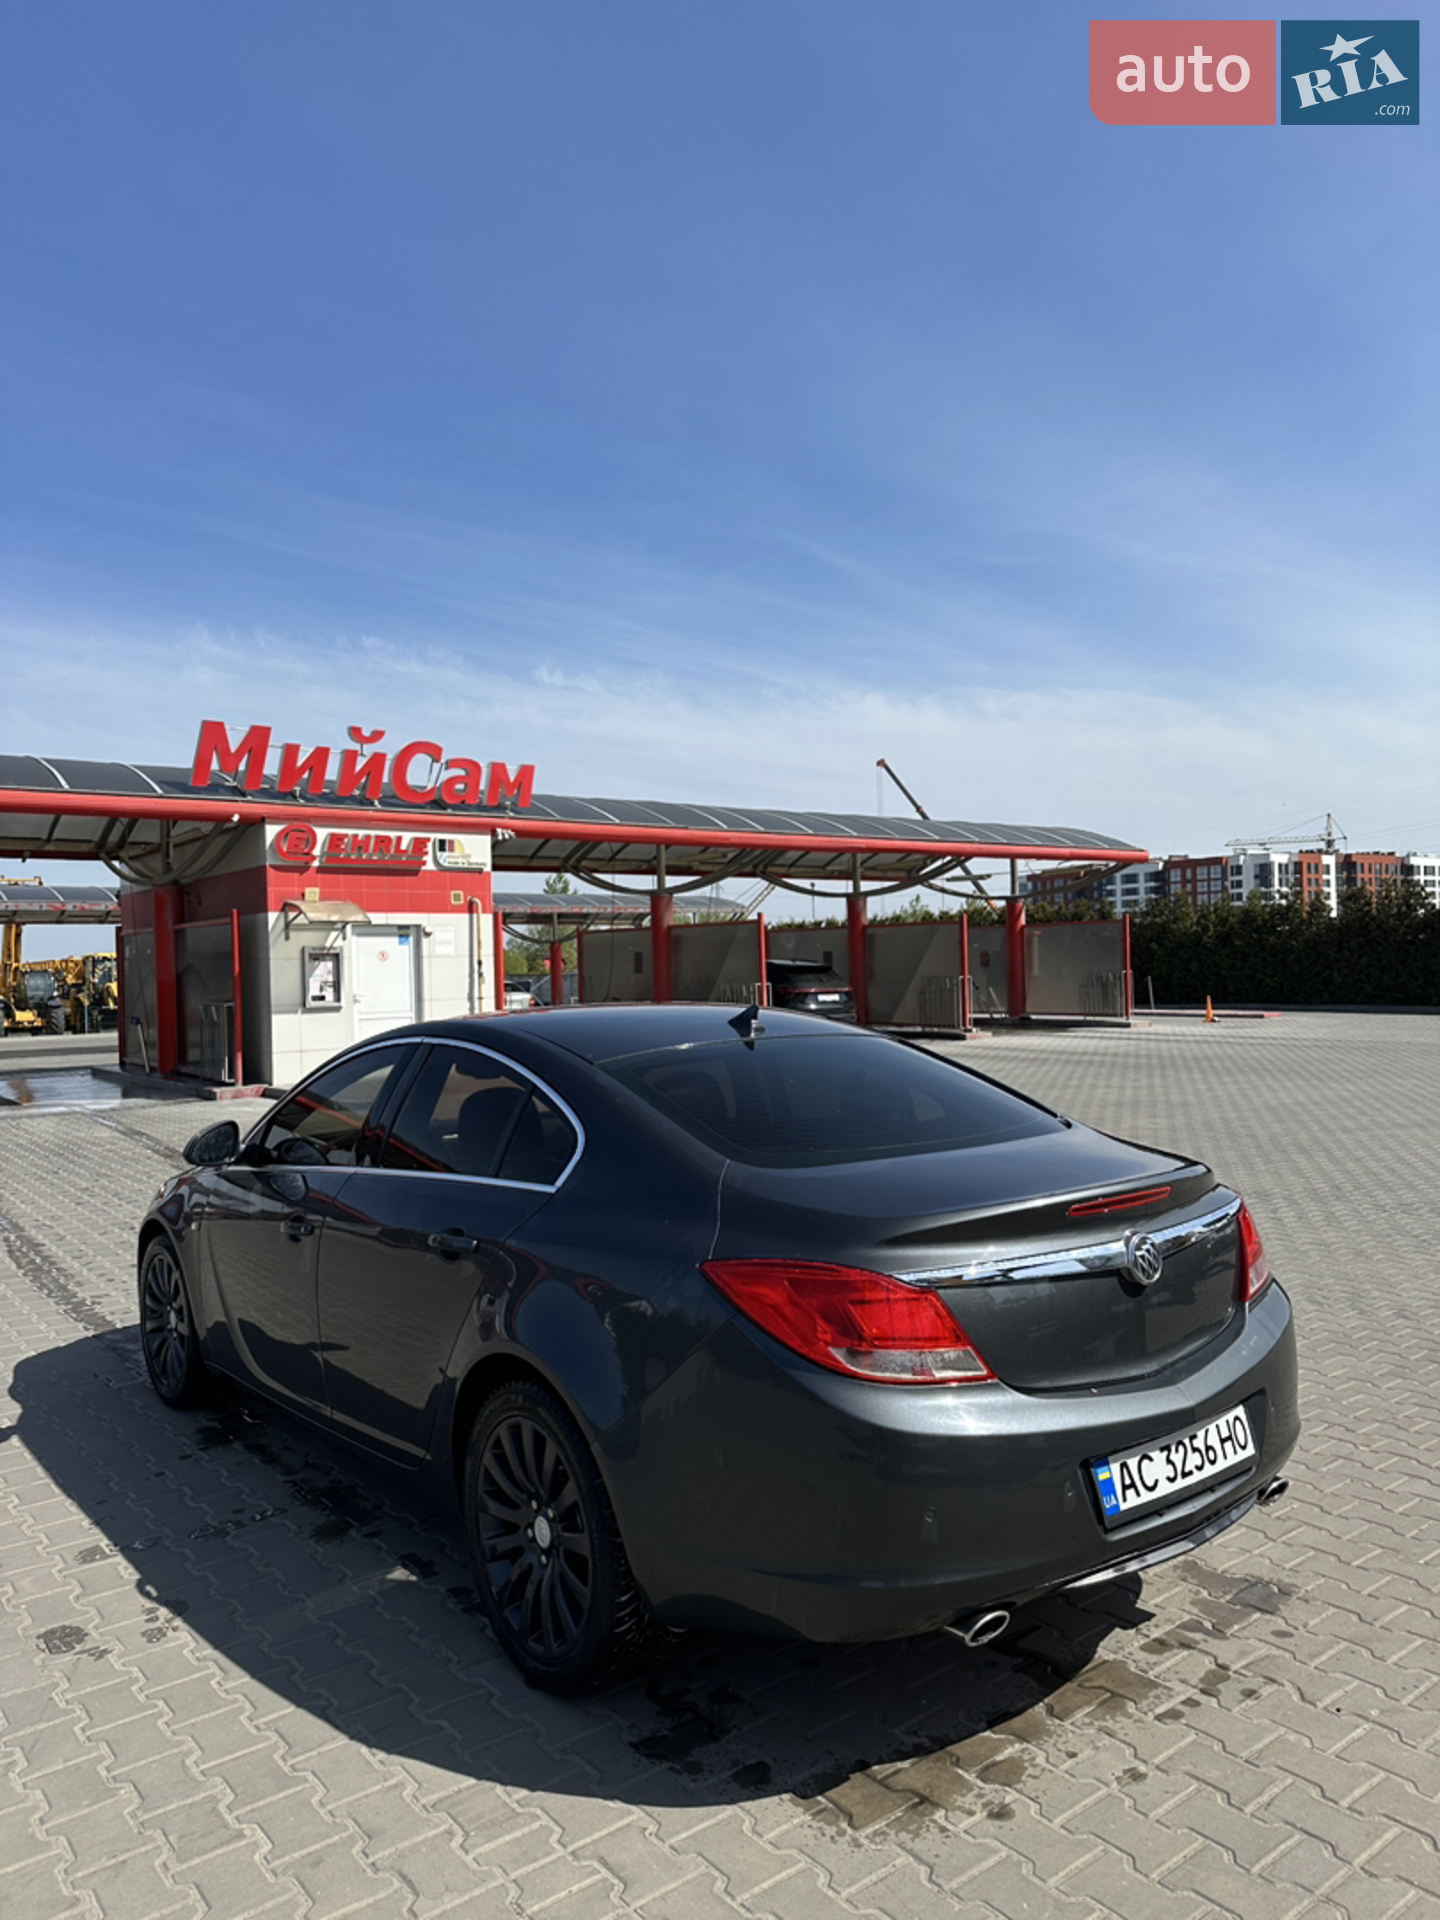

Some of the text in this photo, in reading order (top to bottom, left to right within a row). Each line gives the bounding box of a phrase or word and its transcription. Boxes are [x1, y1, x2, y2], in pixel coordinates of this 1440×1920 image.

[189, 719, 535, 807] МийСам
[325, 832, 431, 855] EHRLE
[1118, 1414, 1249, 1503] AC 3256 HO
[1103, 1493, 1118, 1508] UA
